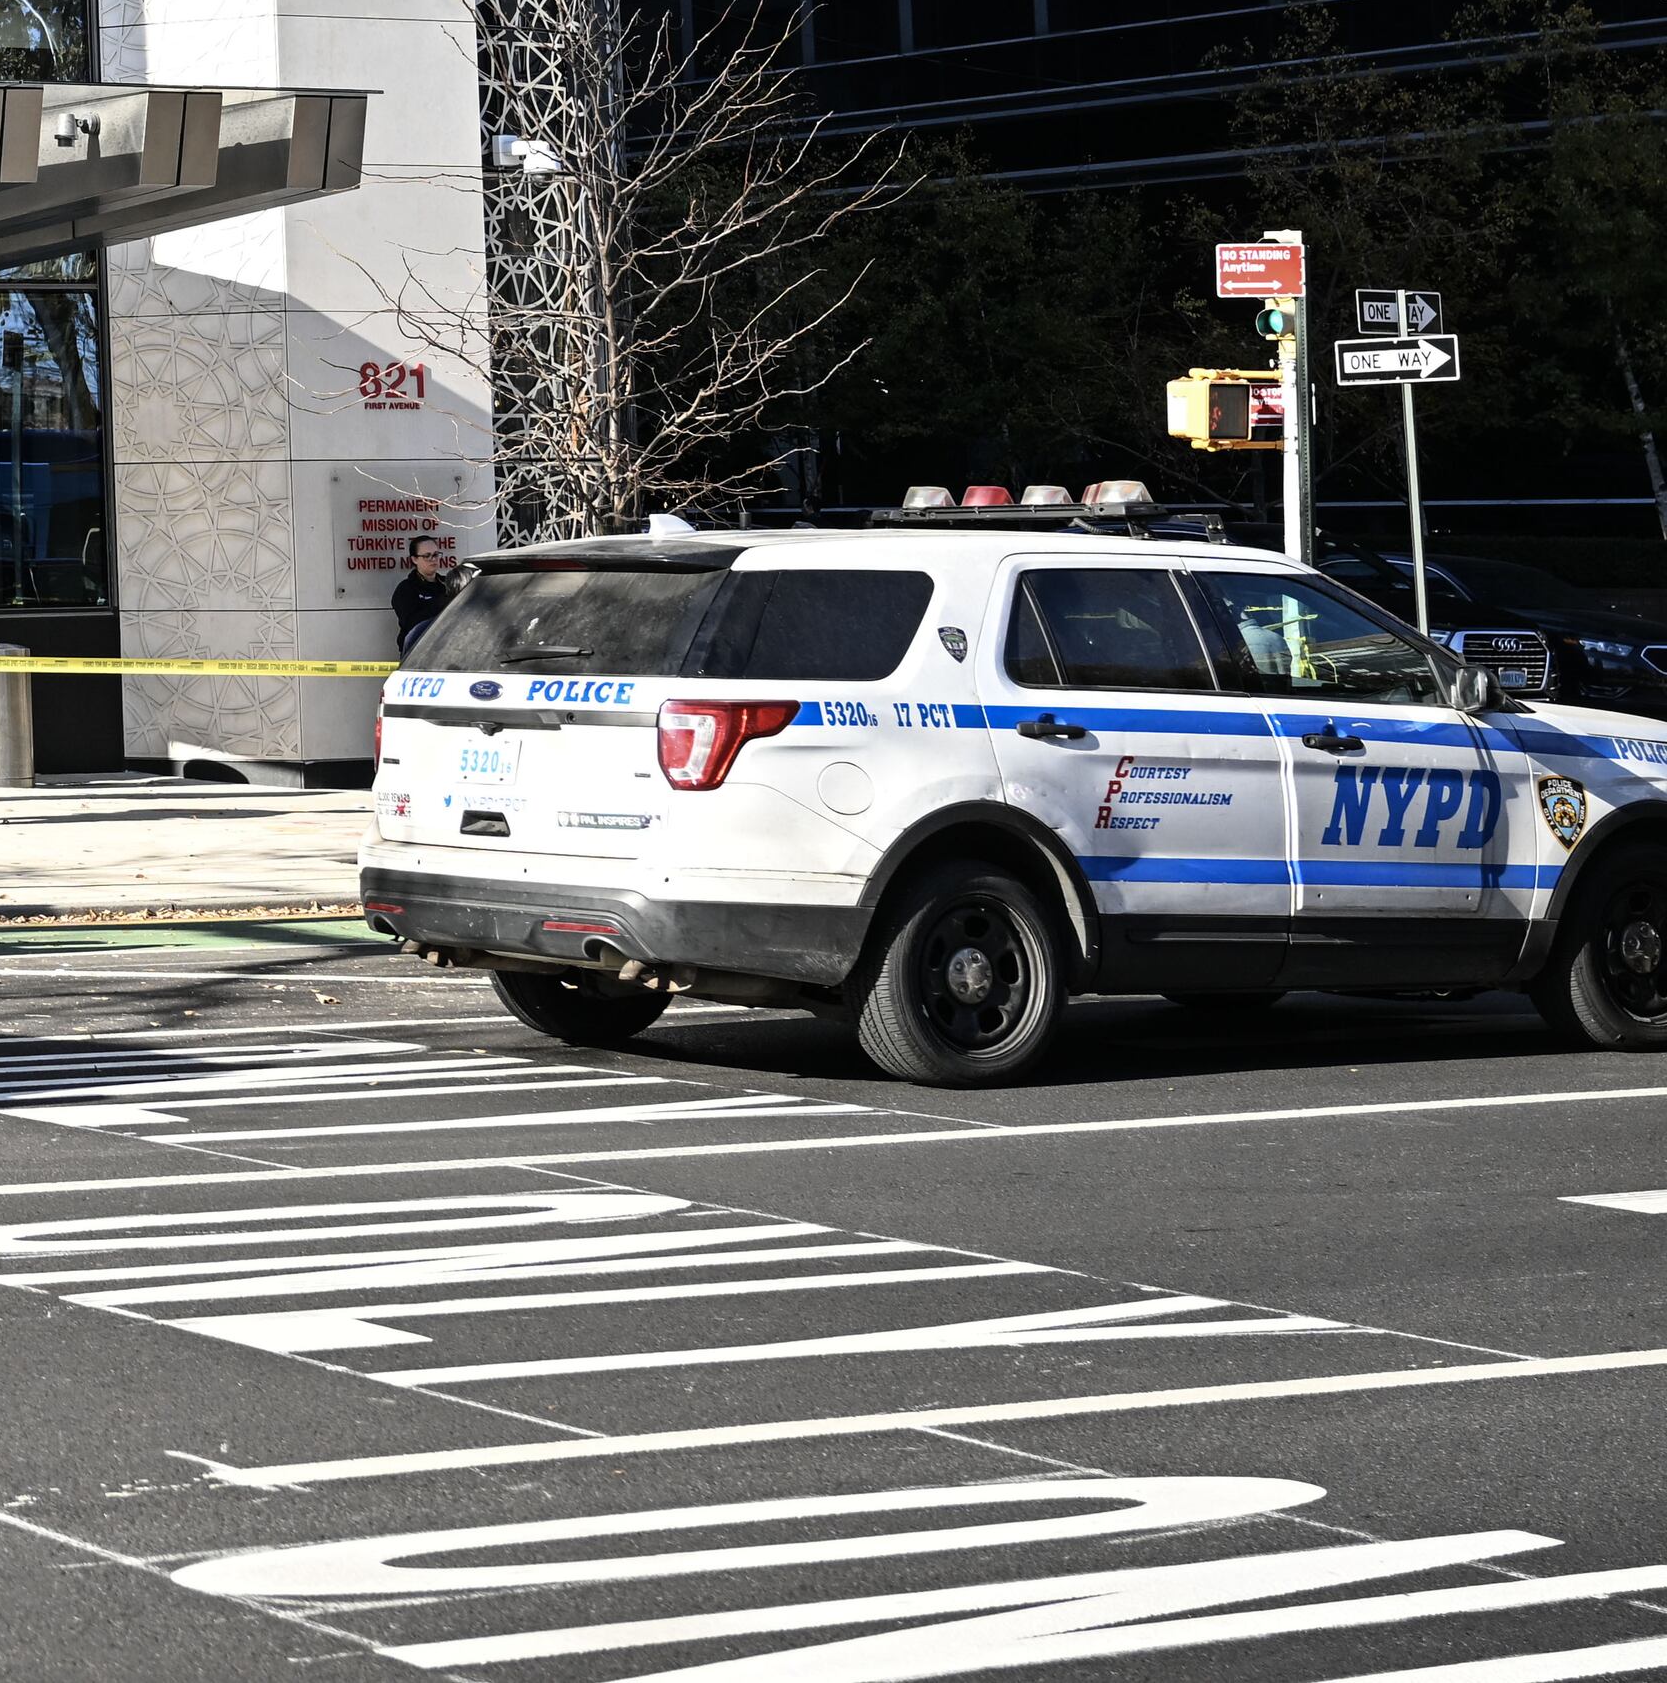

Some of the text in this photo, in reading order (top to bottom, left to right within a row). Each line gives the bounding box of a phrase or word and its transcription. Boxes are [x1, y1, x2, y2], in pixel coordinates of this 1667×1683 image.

[1221, 249, 1291, 261] NO STANDING
[1223, 262, 1266, 275] Anytime
[1367, 304, 1425, 321] ONE AY
[1350, 351, 1431, 370] ONE WAY
[359, 361, 425, 399] 821
[364, 402, 421, 410] FIRST AVENUE
[359, 499, 440, 513] PERMANENT
[362, 518, 440, 531] MISSION OF
[347, 535, 405, 551] TÜRKİYE
[347, 557, 396, 570] UNITED
[397, 676, 445, 698] NYPD
[526, 679, 636, 705] POLICE
[892, 702, 951, 728] 17 PCT
[1614, 737, 1667, 766] POLIC
[1547, 779, 1572, 787] POLICE
[1540, 786, 1584, 801] DEPARTMENT
[1320, 764, 1502, 849] NYPD
[597, 816, 641, 827] INSPIRES
